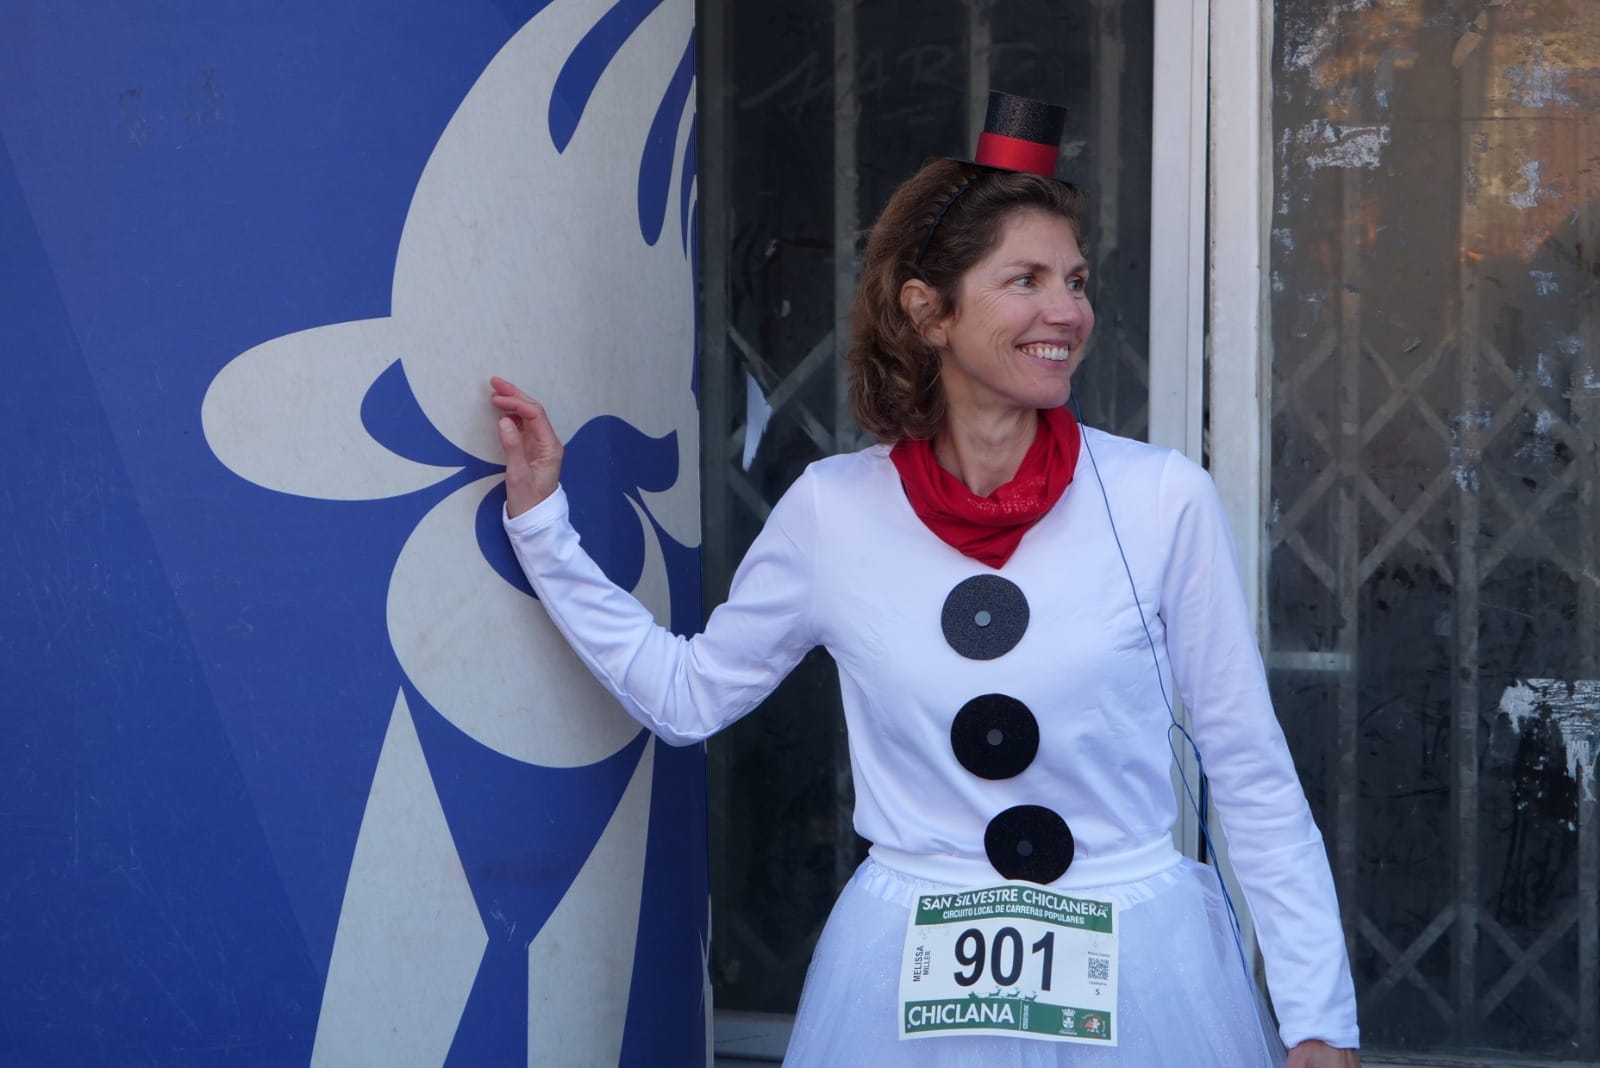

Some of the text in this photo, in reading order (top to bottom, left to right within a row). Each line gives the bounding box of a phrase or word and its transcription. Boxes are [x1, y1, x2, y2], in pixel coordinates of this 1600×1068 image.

[922, 888, 1108, 918] SAN SILVESTRE CHICLANERA
[943, 904, 1085, 925] CIRCUITO LOCAL DE CARRERAS POPULARES
[913, 945, 925, 982] MELISSA
[922, 950, 931, 976] MILLER
[953, 926, 1055, 992] 901
[908, 1003, 1015, 1026] CHICLANA
